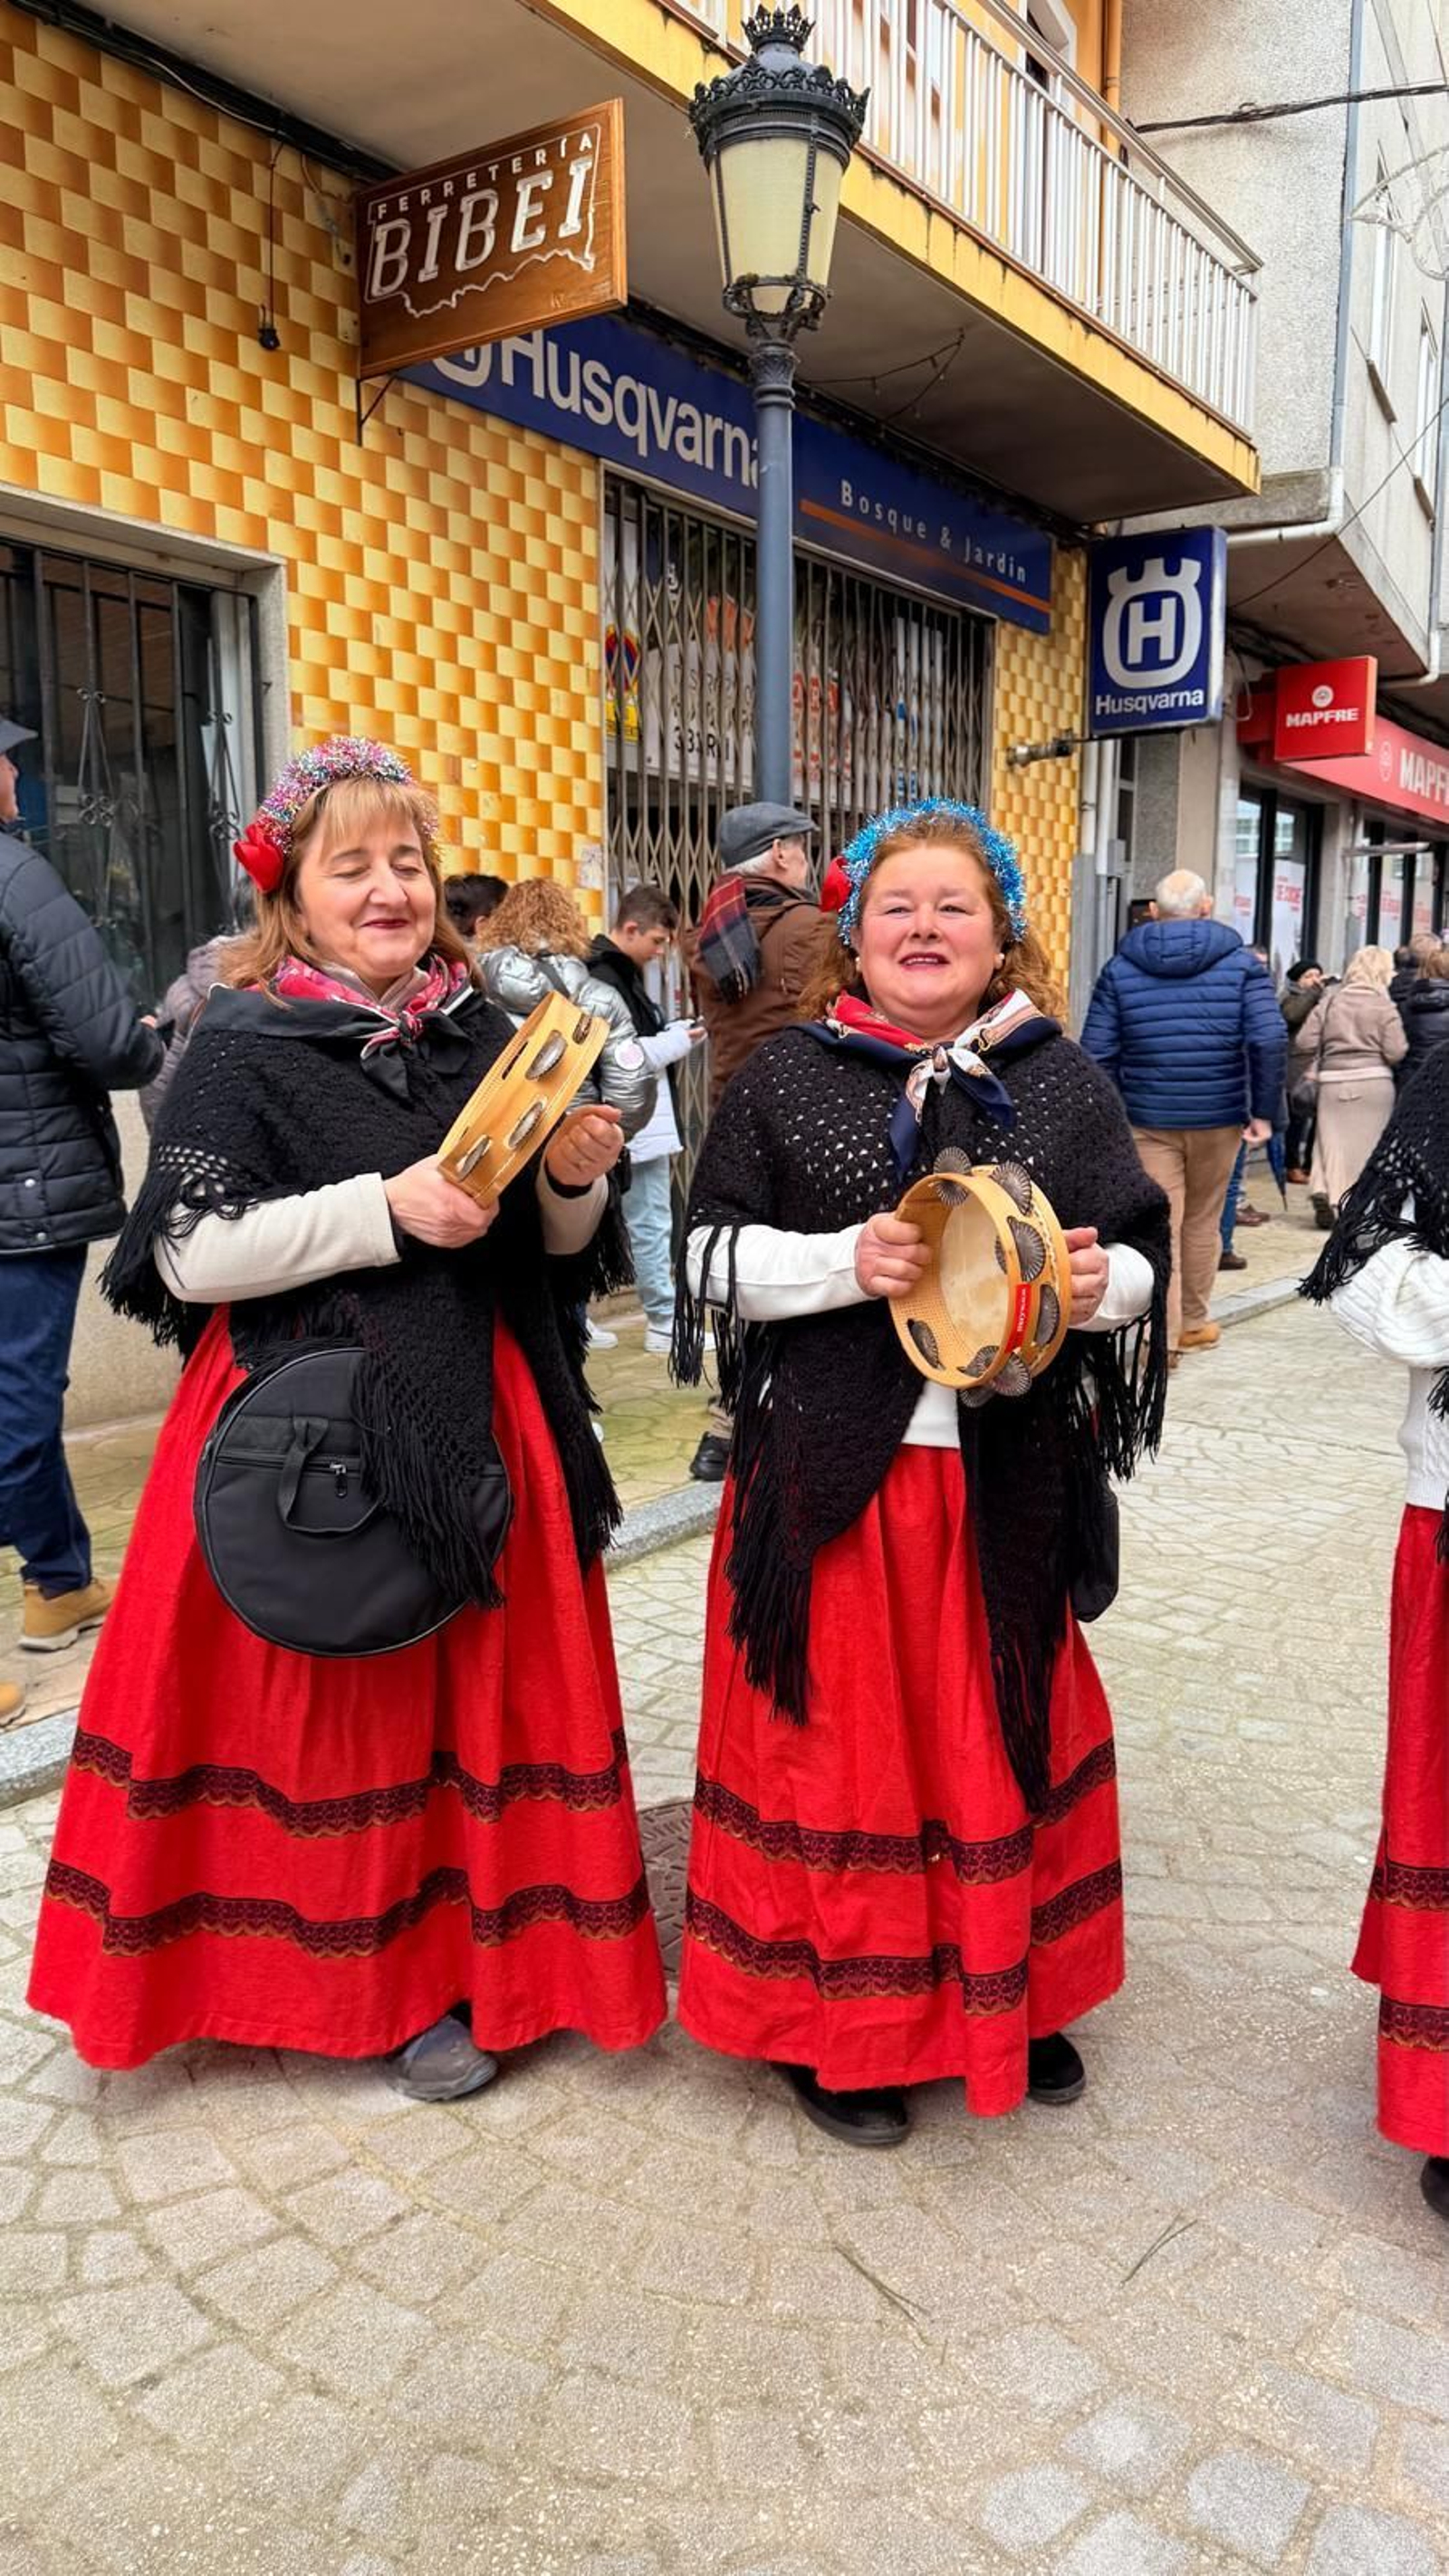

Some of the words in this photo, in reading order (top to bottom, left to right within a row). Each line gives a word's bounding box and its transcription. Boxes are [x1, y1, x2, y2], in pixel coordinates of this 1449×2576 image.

[370, 154, 594, 298] BIBEI
[840, 478, 926, 539] Bosque
[939, 526, 952, 551] &
[1094, 688, 1204, 716] Husqvarna
[1286, 707, 1359, 728] MAPFRE
